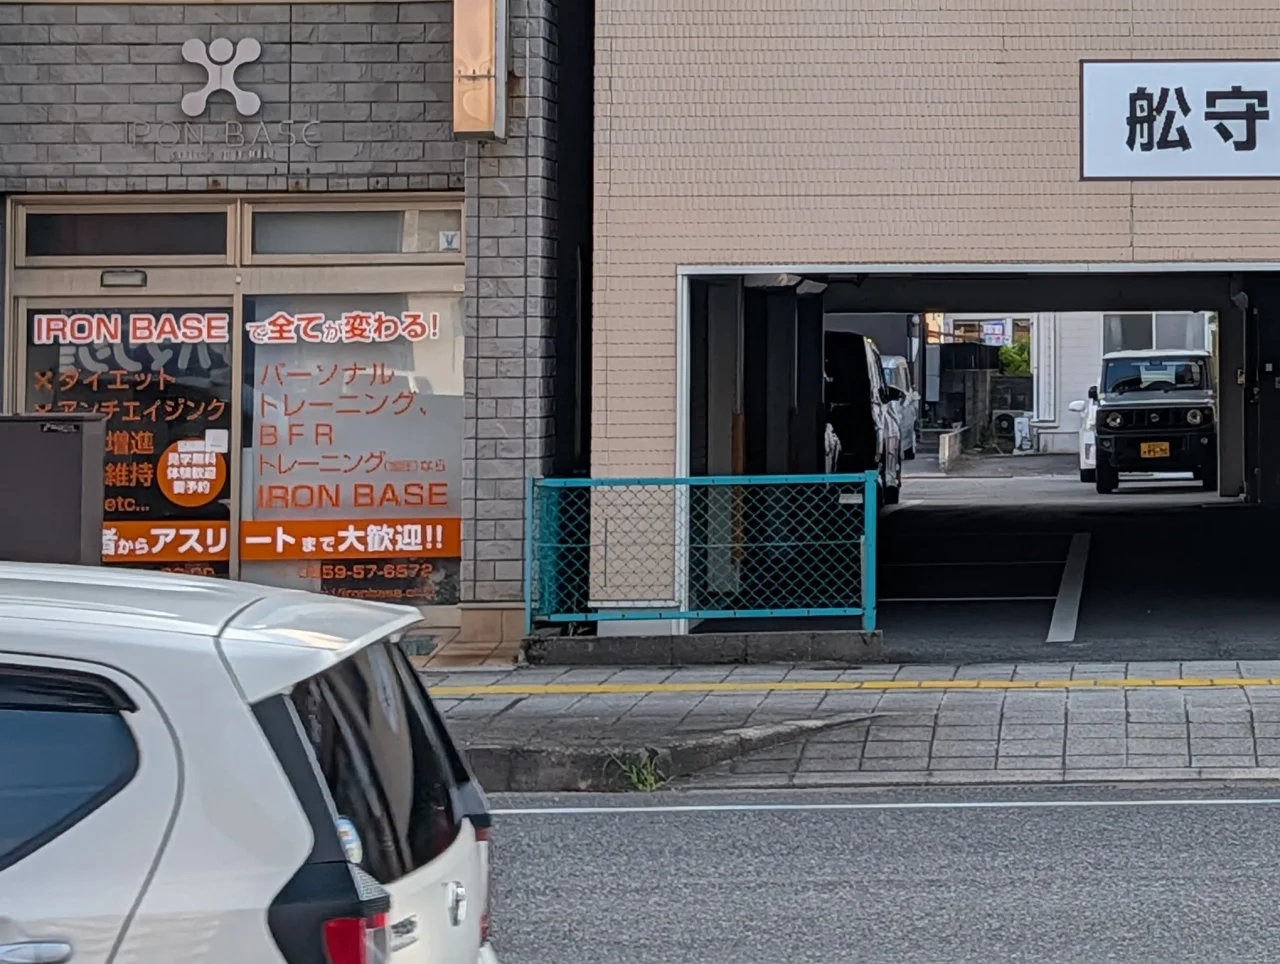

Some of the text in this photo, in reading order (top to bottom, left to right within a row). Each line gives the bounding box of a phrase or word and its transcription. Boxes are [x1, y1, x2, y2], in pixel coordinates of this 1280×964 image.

[225, 119, 321, 148] BASE
[34, 311, 439, 344] IRON BASE で全てが変わる!
[59, 367, 176, 391] ダイエット
[260, 362, 395, 386] パーソナル
[105, 430, 154, 456] 増進
[104, 462, 154, 487] 維持
[257, 482, 448, 509] IRON BASE
